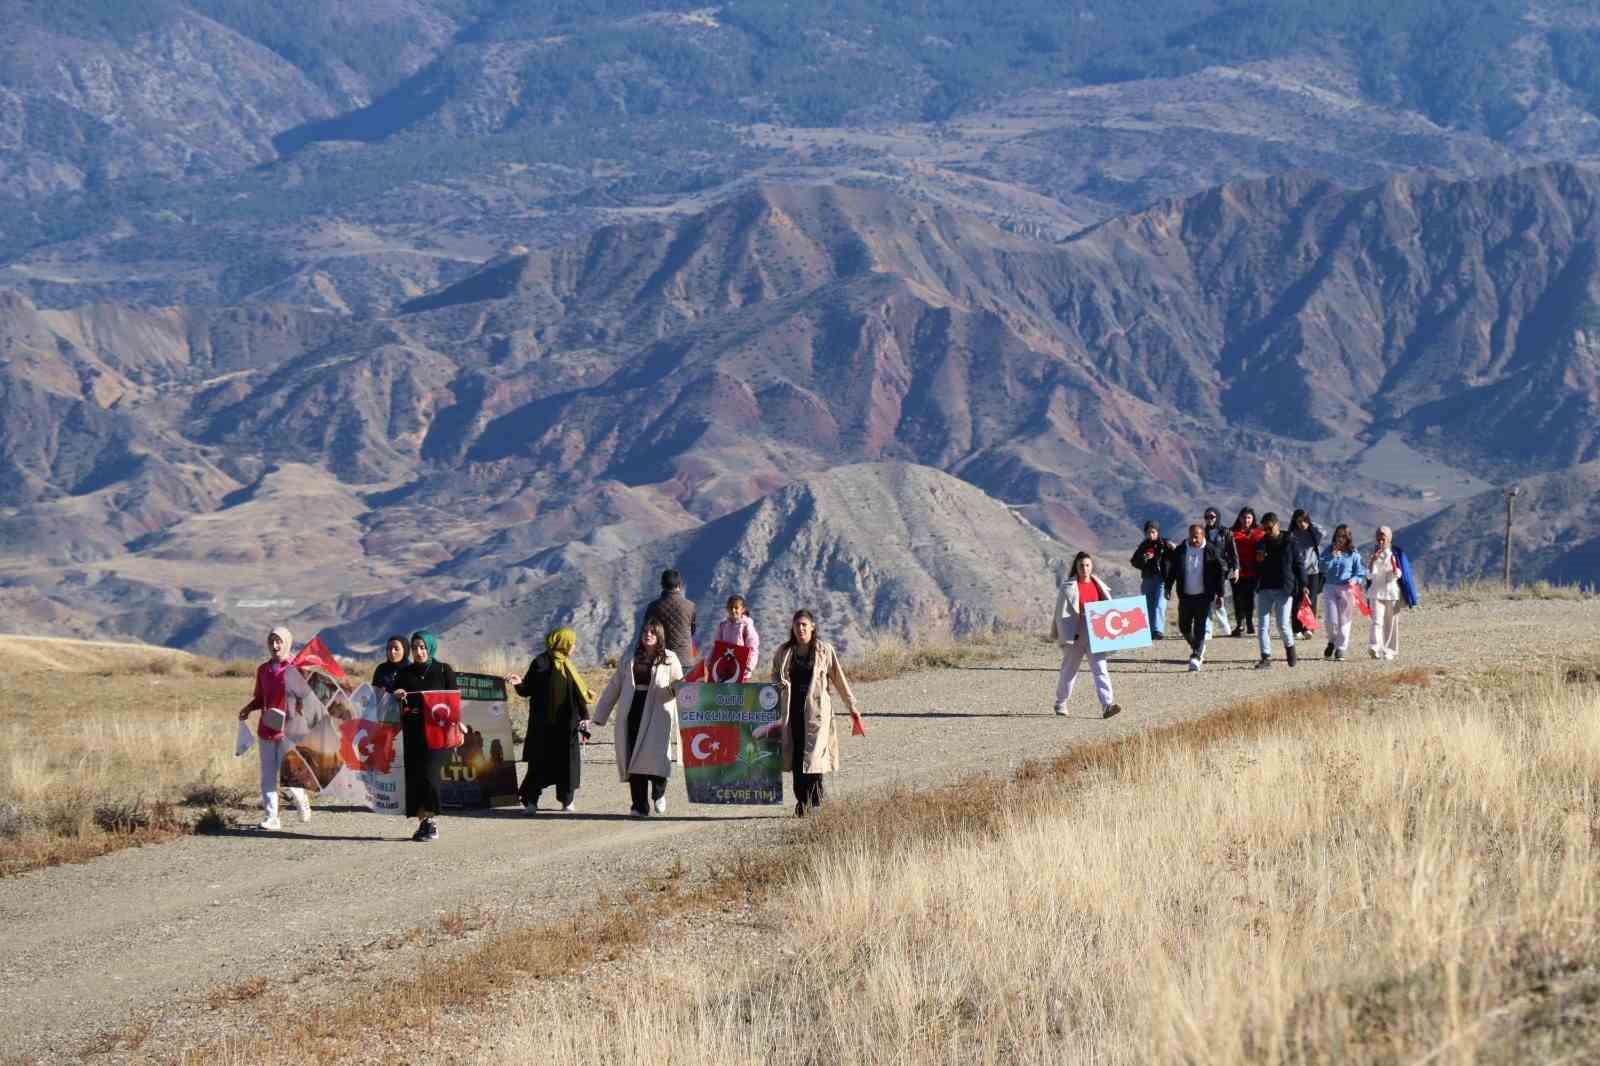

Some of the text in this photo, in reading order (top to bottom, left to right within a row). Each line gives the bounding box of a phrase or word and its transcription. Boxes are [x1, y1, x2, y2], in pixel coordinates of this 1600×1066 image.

[681, 709, 780, 722] GENÇLİK MERKEZİ
[440, 765, 477, 782] LTU
